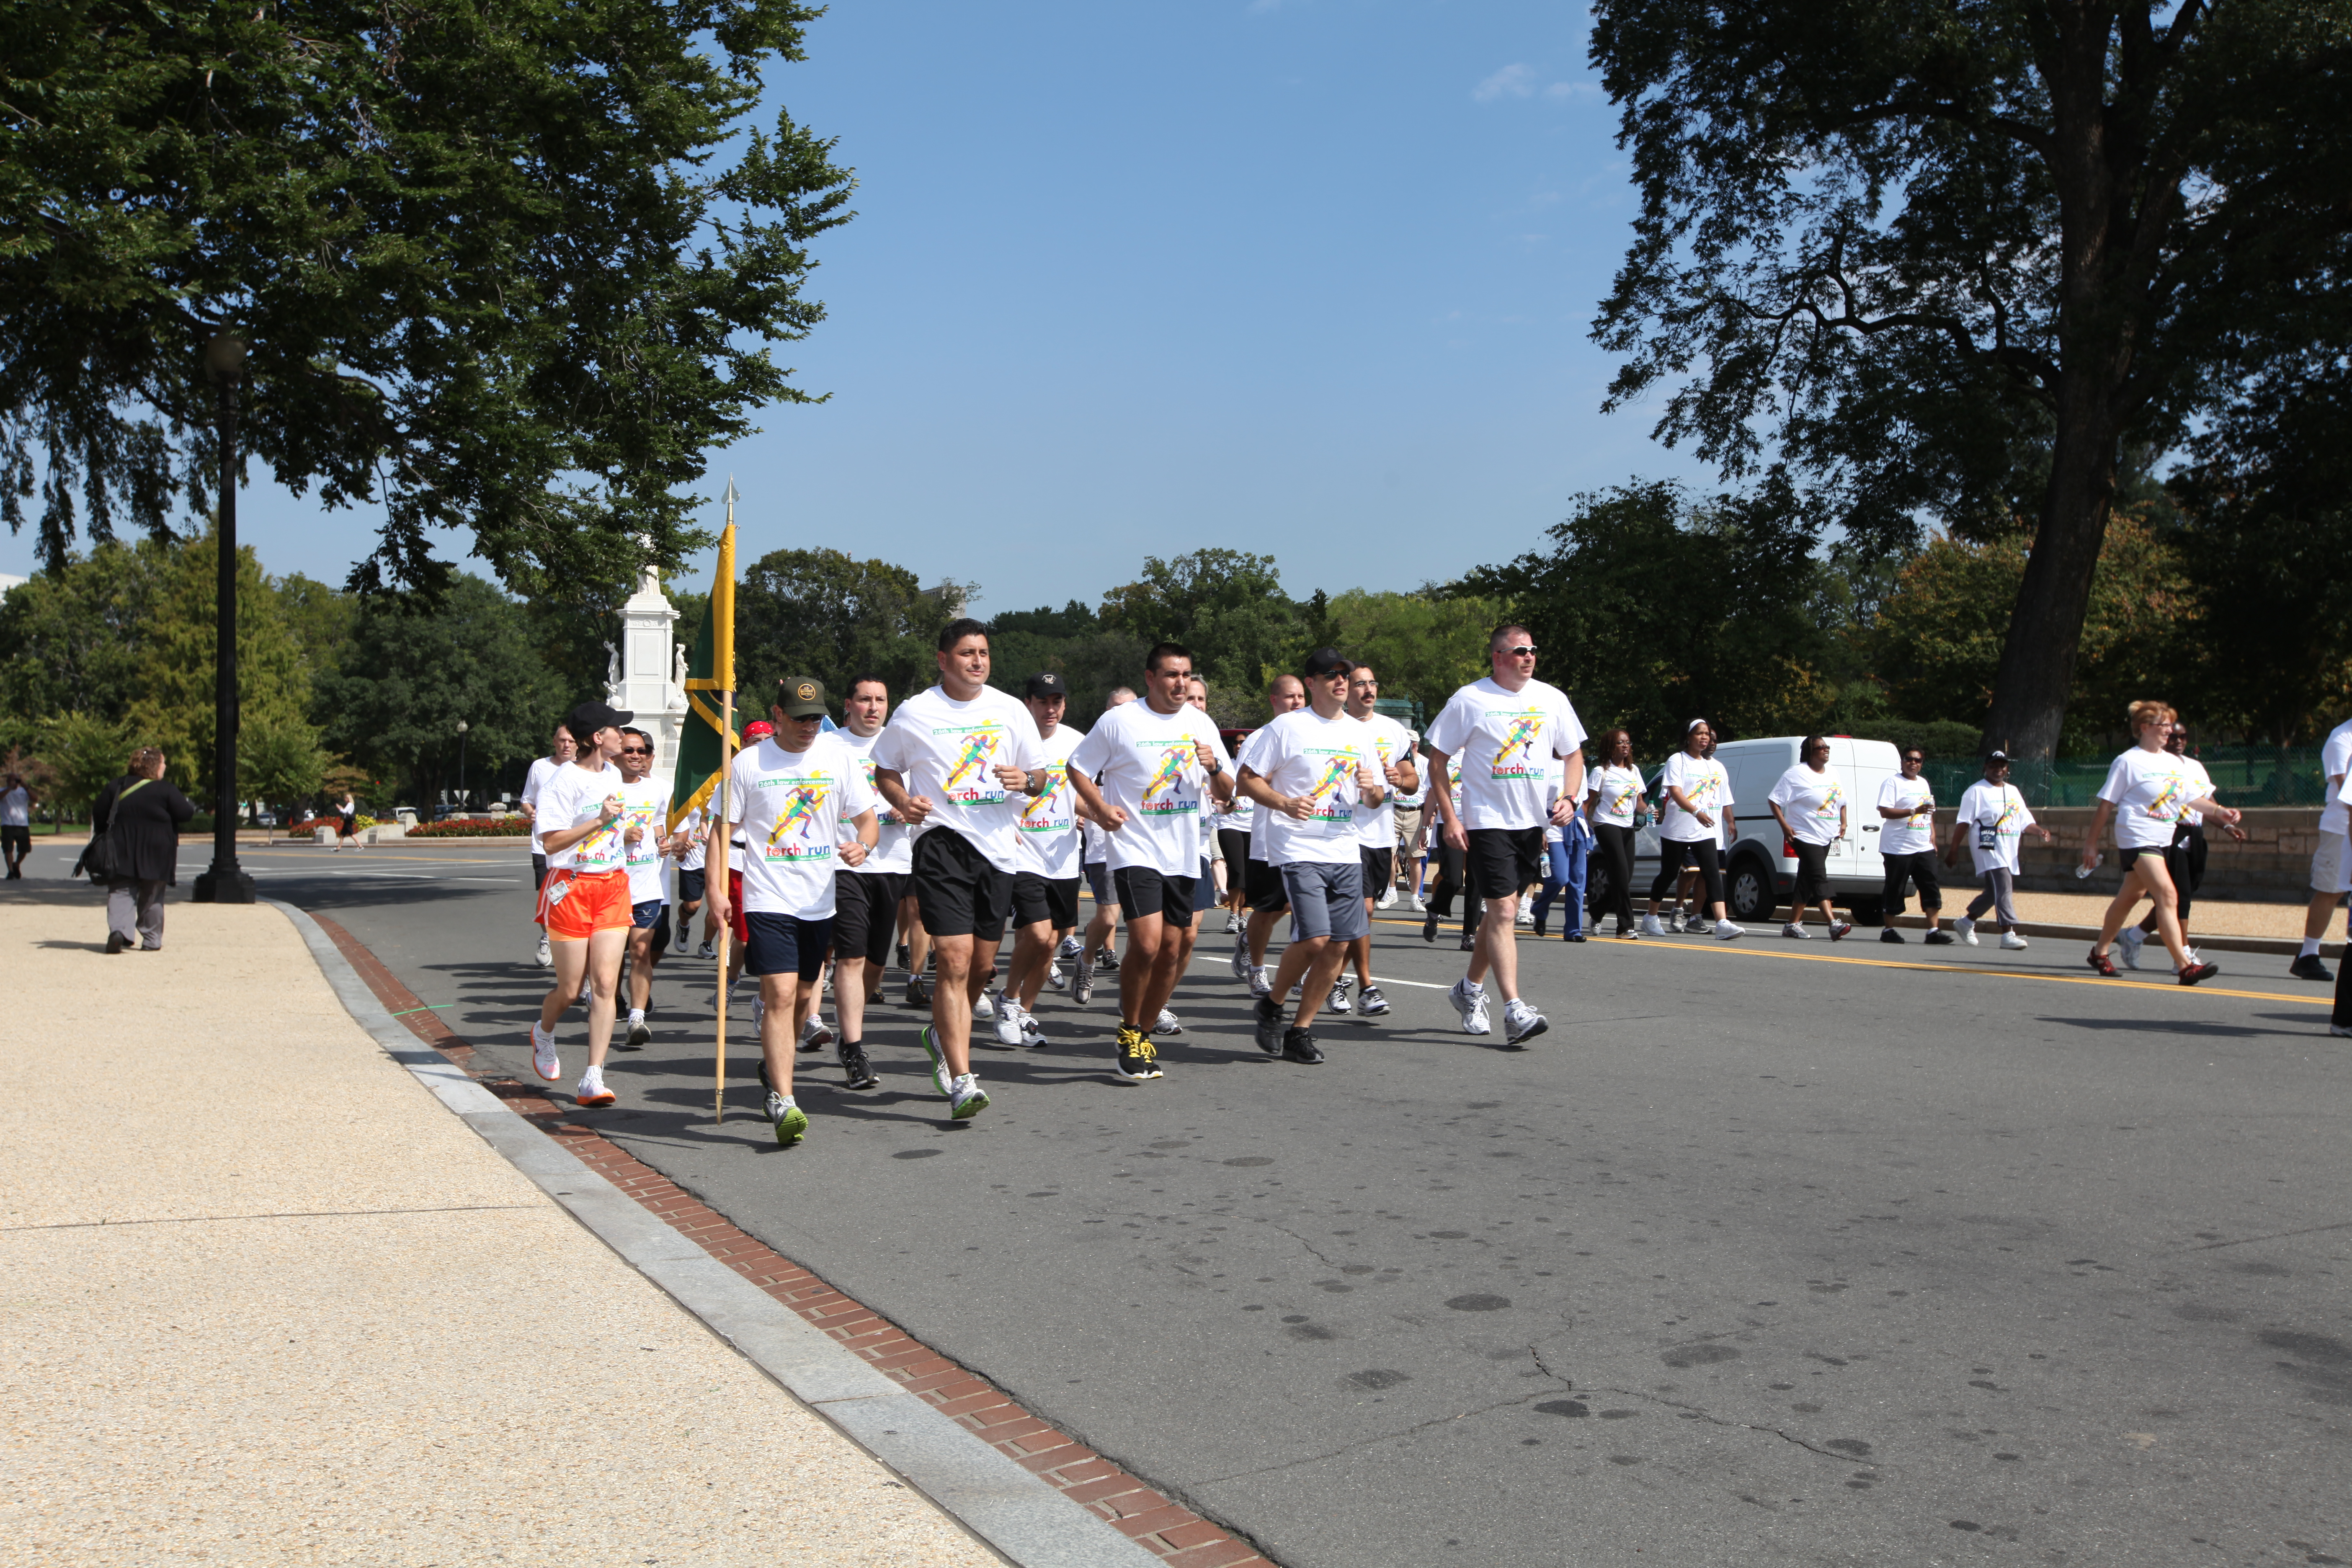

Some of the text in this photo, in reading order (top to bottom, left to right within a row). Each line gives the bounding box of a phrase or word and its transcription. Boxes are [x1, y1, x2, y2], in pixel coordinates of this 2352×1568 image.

[1330, 750, 1360, 758] enforcement
[1492, 763, 1524, 774] torch
[948, 787, 1004, 801] orch run
[583, 804, 597, 812] 26th
[1141, 798, 1197, 810] torch run
[1020, 817, 1049, 828] torch
[766, 843, 830, 856] torch run
